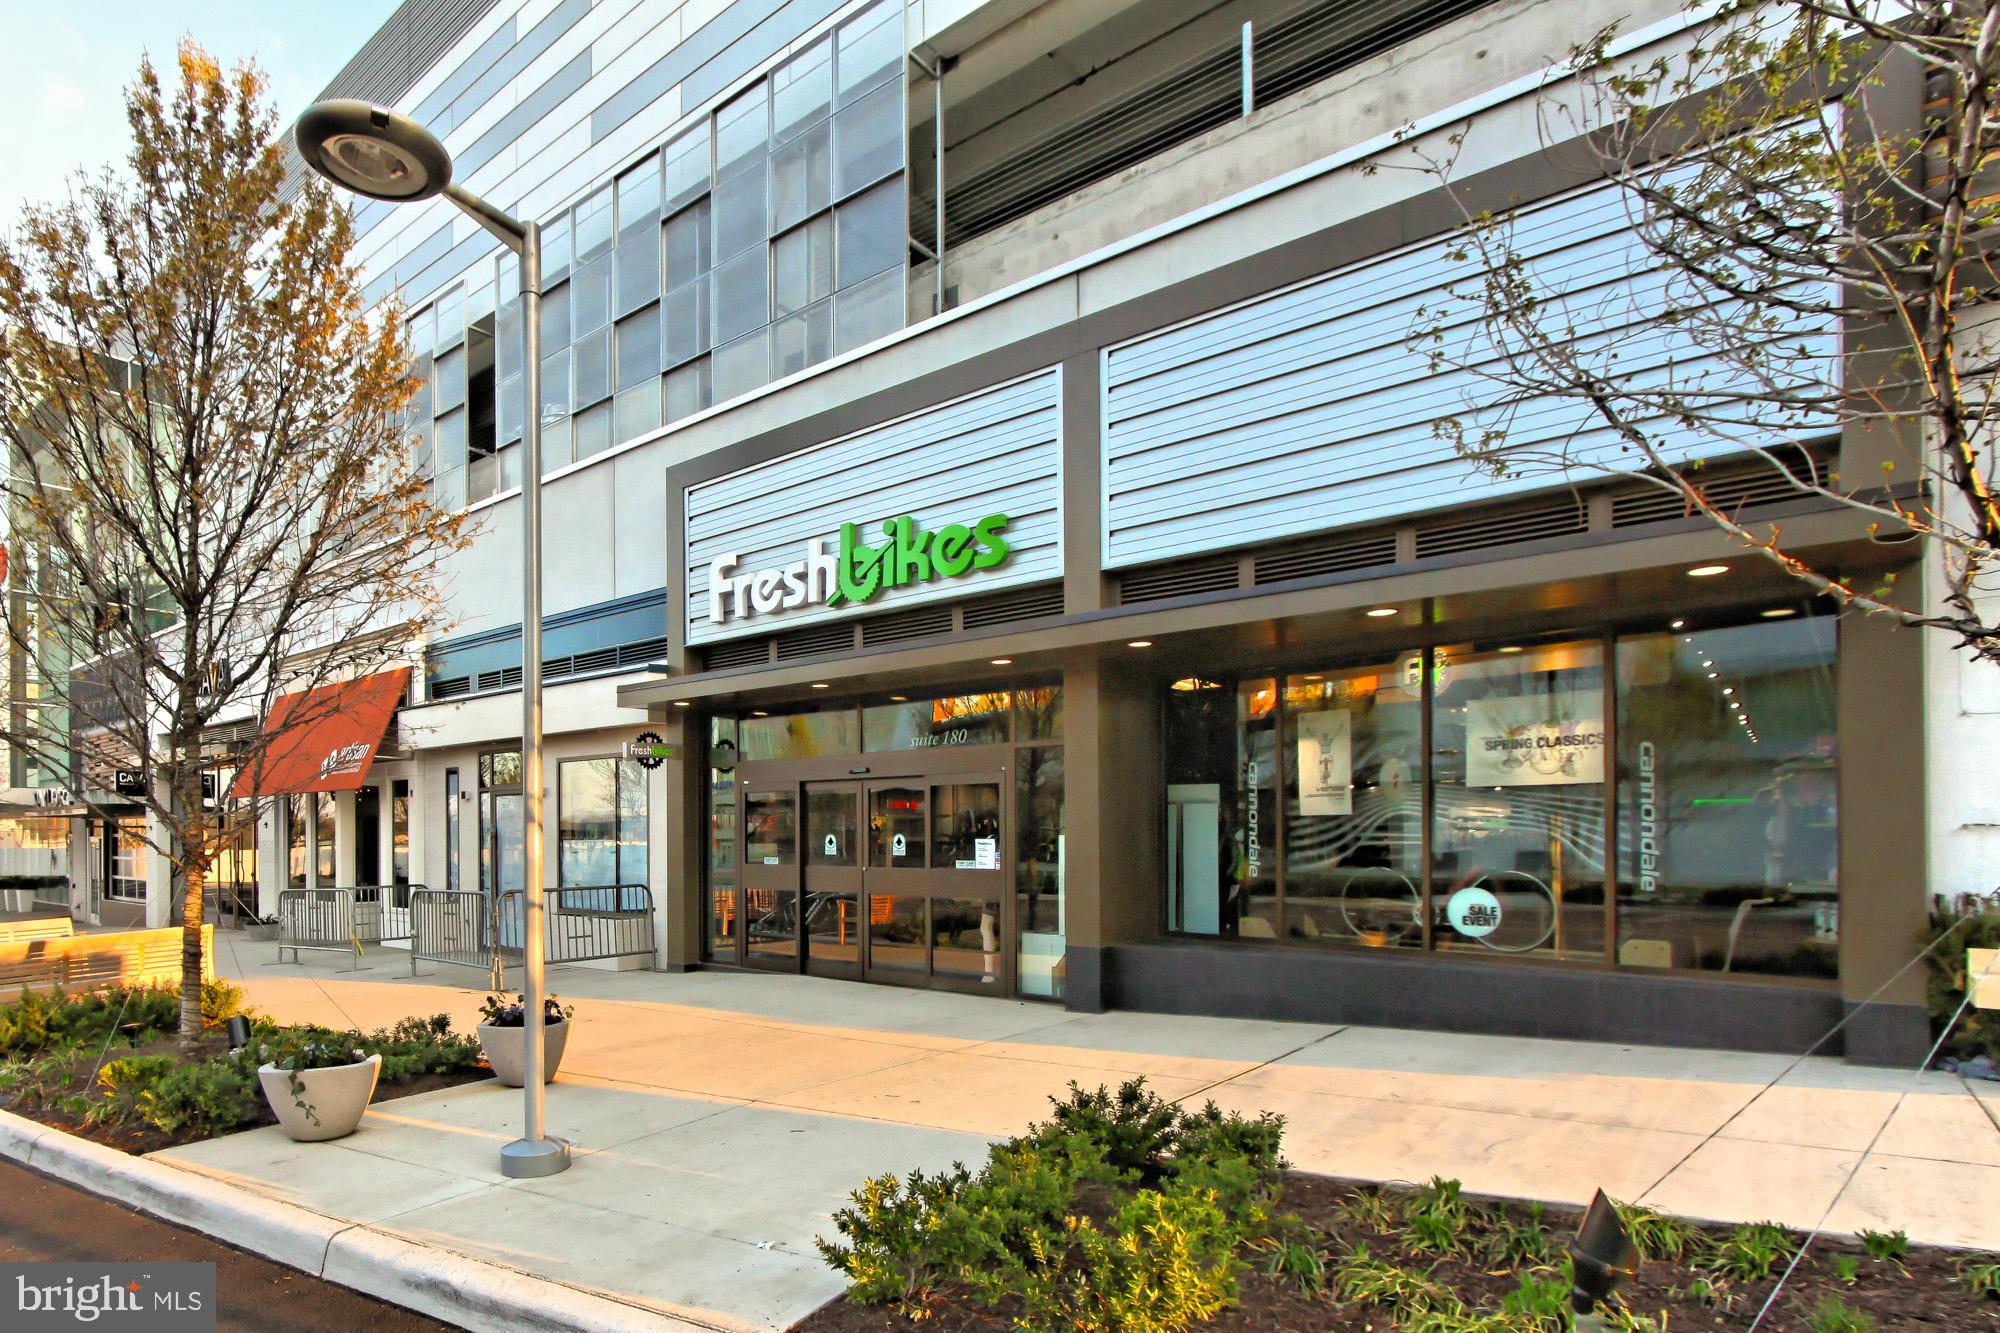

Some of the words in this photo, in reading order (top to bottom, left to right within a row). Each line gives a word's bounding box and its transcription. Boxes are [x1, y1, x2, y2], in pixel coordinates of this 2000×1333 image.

[910, 733, 939, 747] suite
[942, 728, 968, 745] 180
[1485, 738, 1533, 751] SPRING
[1248, 761, 1261, 878] cannondale
[1639, 741, 1660, 892] cannondale
[1469, 906, 1498, 916] SALE
[1462, 915, 1498, 927] EVENT
